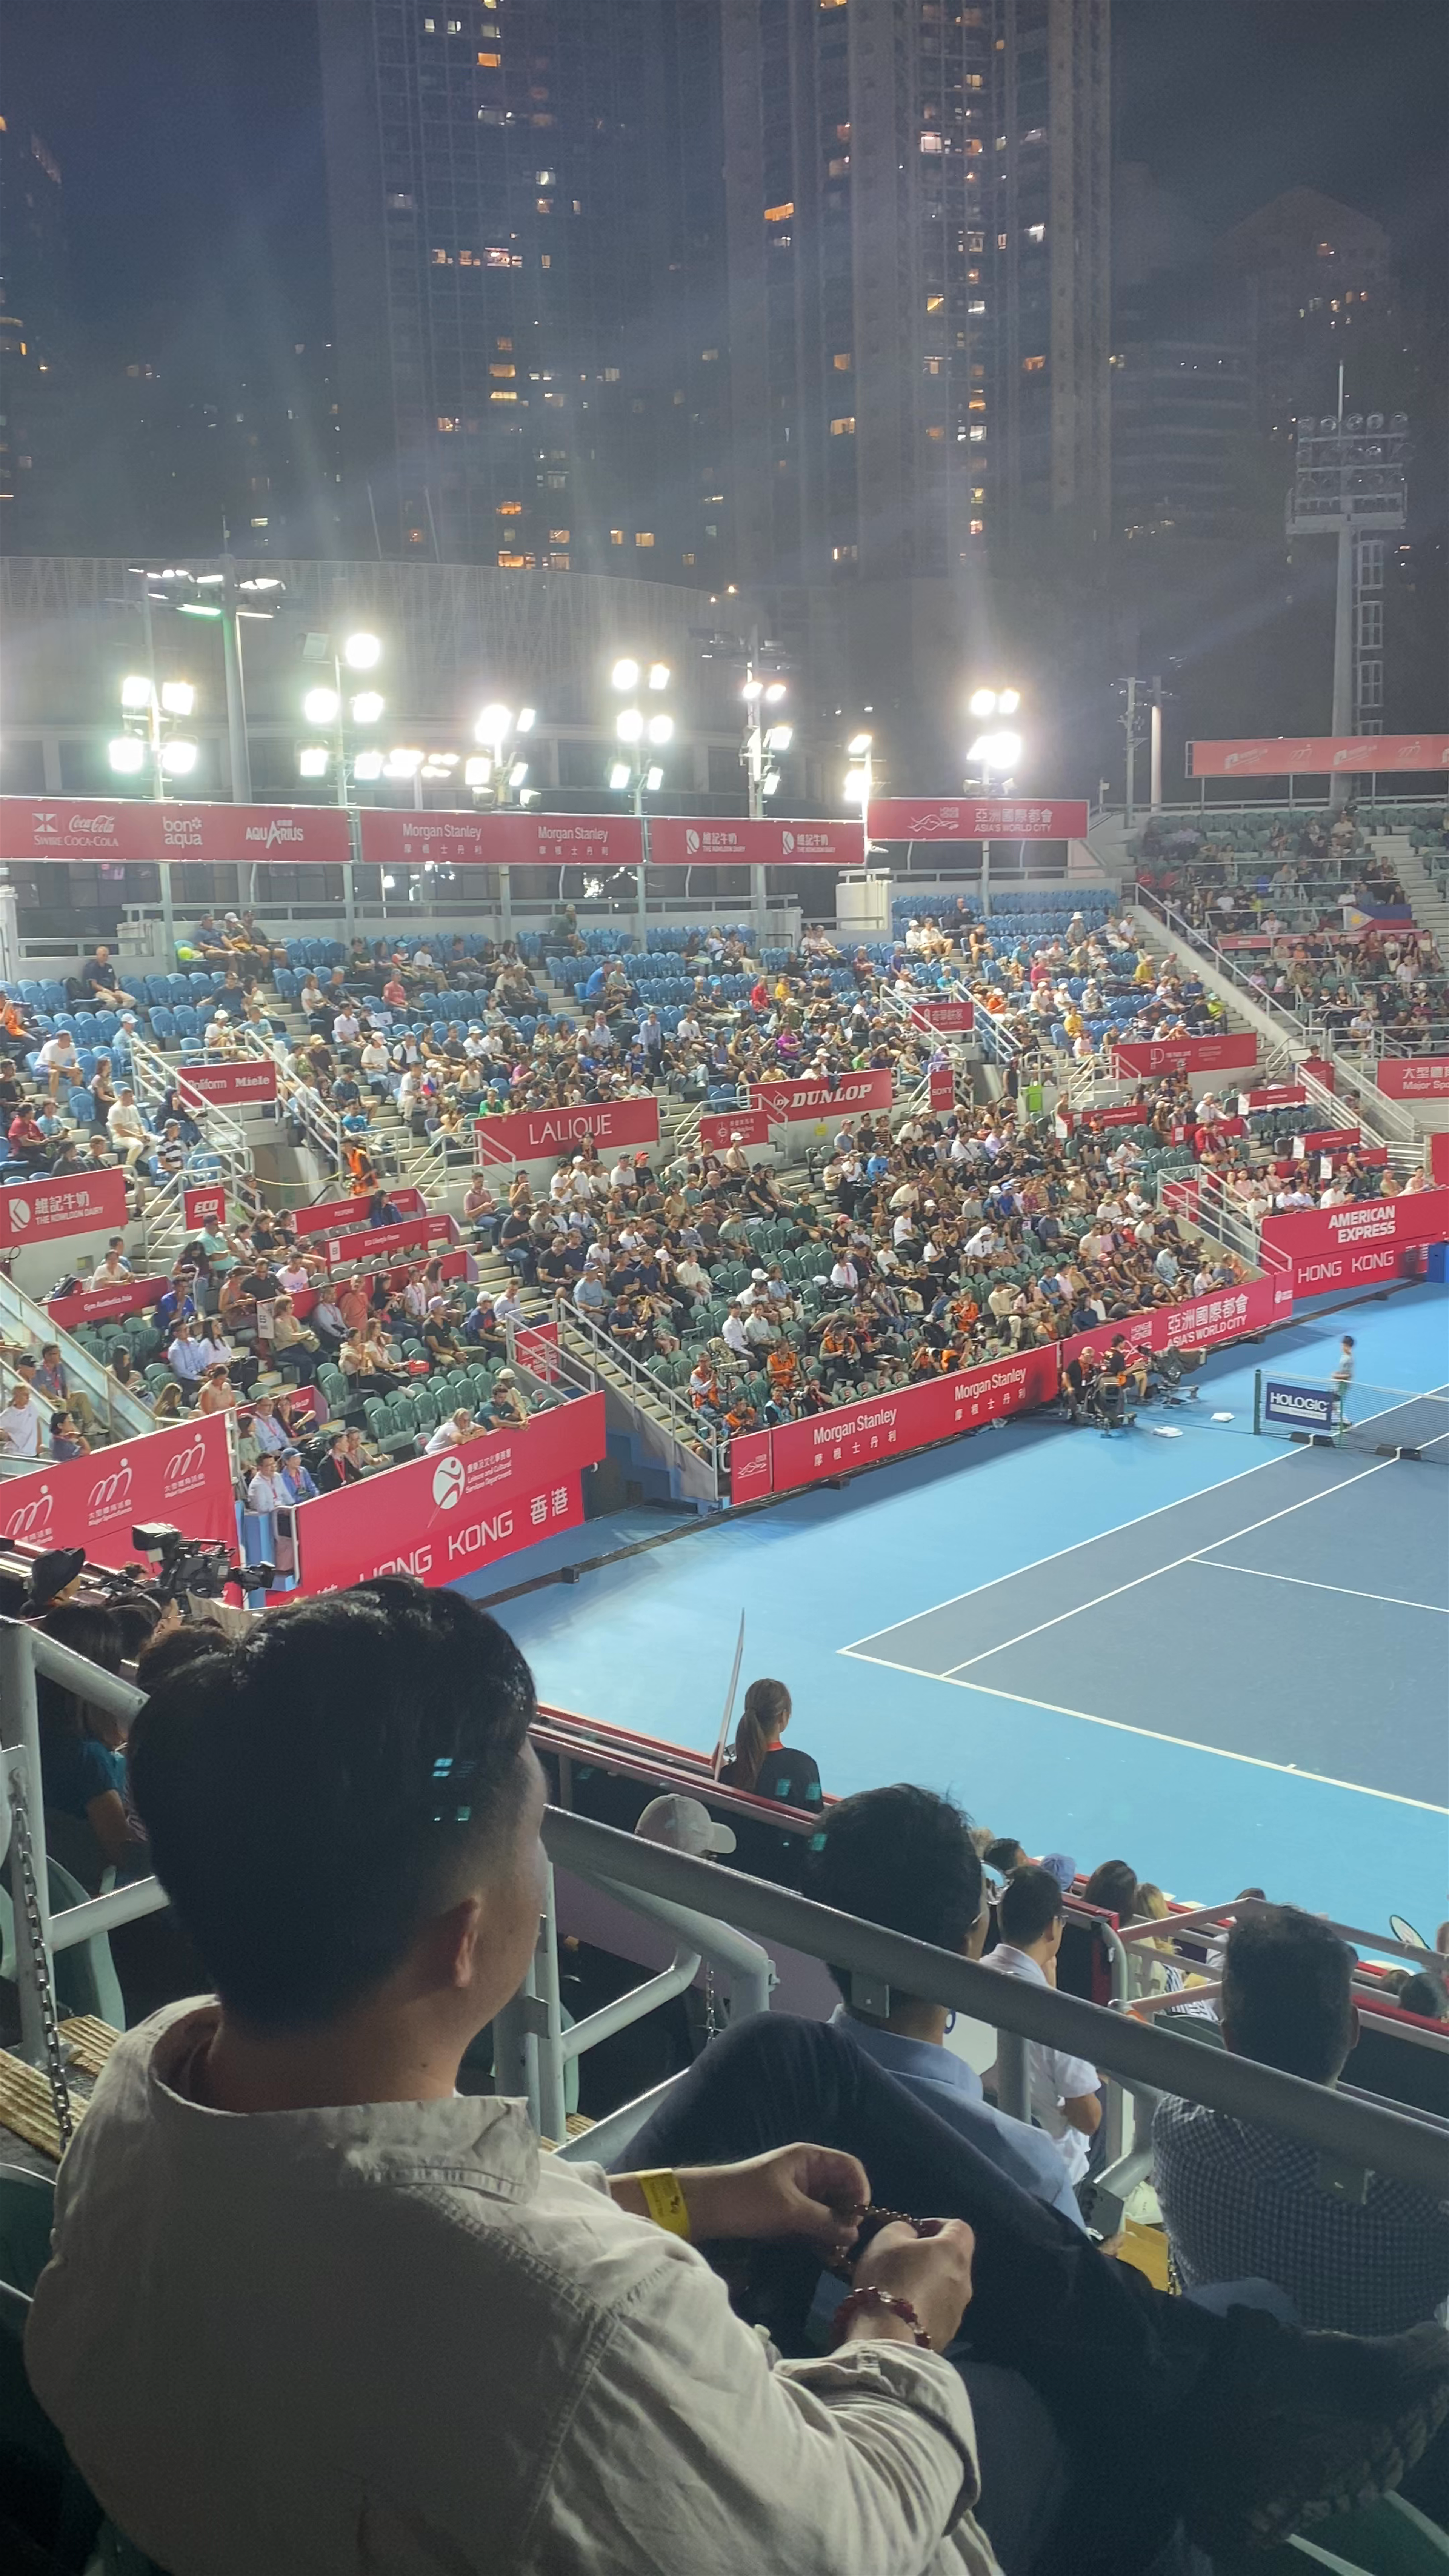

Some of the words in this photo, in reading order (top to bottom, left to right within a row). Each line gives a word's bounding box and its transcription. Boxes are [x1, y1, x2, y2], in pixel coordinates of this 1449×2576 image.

[163, 817, 191, 832] bon
[246, 821, 303, 849] AQUARIUS
[403, 823, 443, 840] Morgan
[444, 824, 482, 841] Stanley
[538, 826, 574, 842] Morgan
[575, 827, 608, 843] Stanley
[64, 835, 119, 847] COCA-COLA
[164, 833, 203, 848] aqua
[235, 1076, 270, 1087] Miele
[932, 1087, 952, 1096] SONY
[791, 1084, 872, 1108] DUNLOP
[529, 1114, 612, 1145] LALIQUE
[35, 1191, 90, 1215] 維記牛奶
[36, 1215, 50, 1225] THE
[1328, 1205, 1395, 1229] AMERICAN
[1338, 1221, 1396, 1243] EXPRESS
[1298, 1261, 1342, 1283] HONG
[1352, 1250, 1394, 1273] KONG
[1167, 1293, 1249, 1336] 亞洲國際都會
[1167, 1331, 1195, 1347] ASIA'S
[1195, 1321, 1226, 1340] WORLD
[1227, 1315, 1247, 1330] CITY
[955, 1379, 991, 1401] Morgan
[992, 1368, 1026, 1389] Stanley
[1270, 1392, 1328, 1412] HOLOGIC
[814, 1422, 856, 1445] Morgan
[857, 1408, 897, 1432] Stanley
[530, 1486, 568, 1526] 香港
[448, 1510, 513, 1561] KONG
